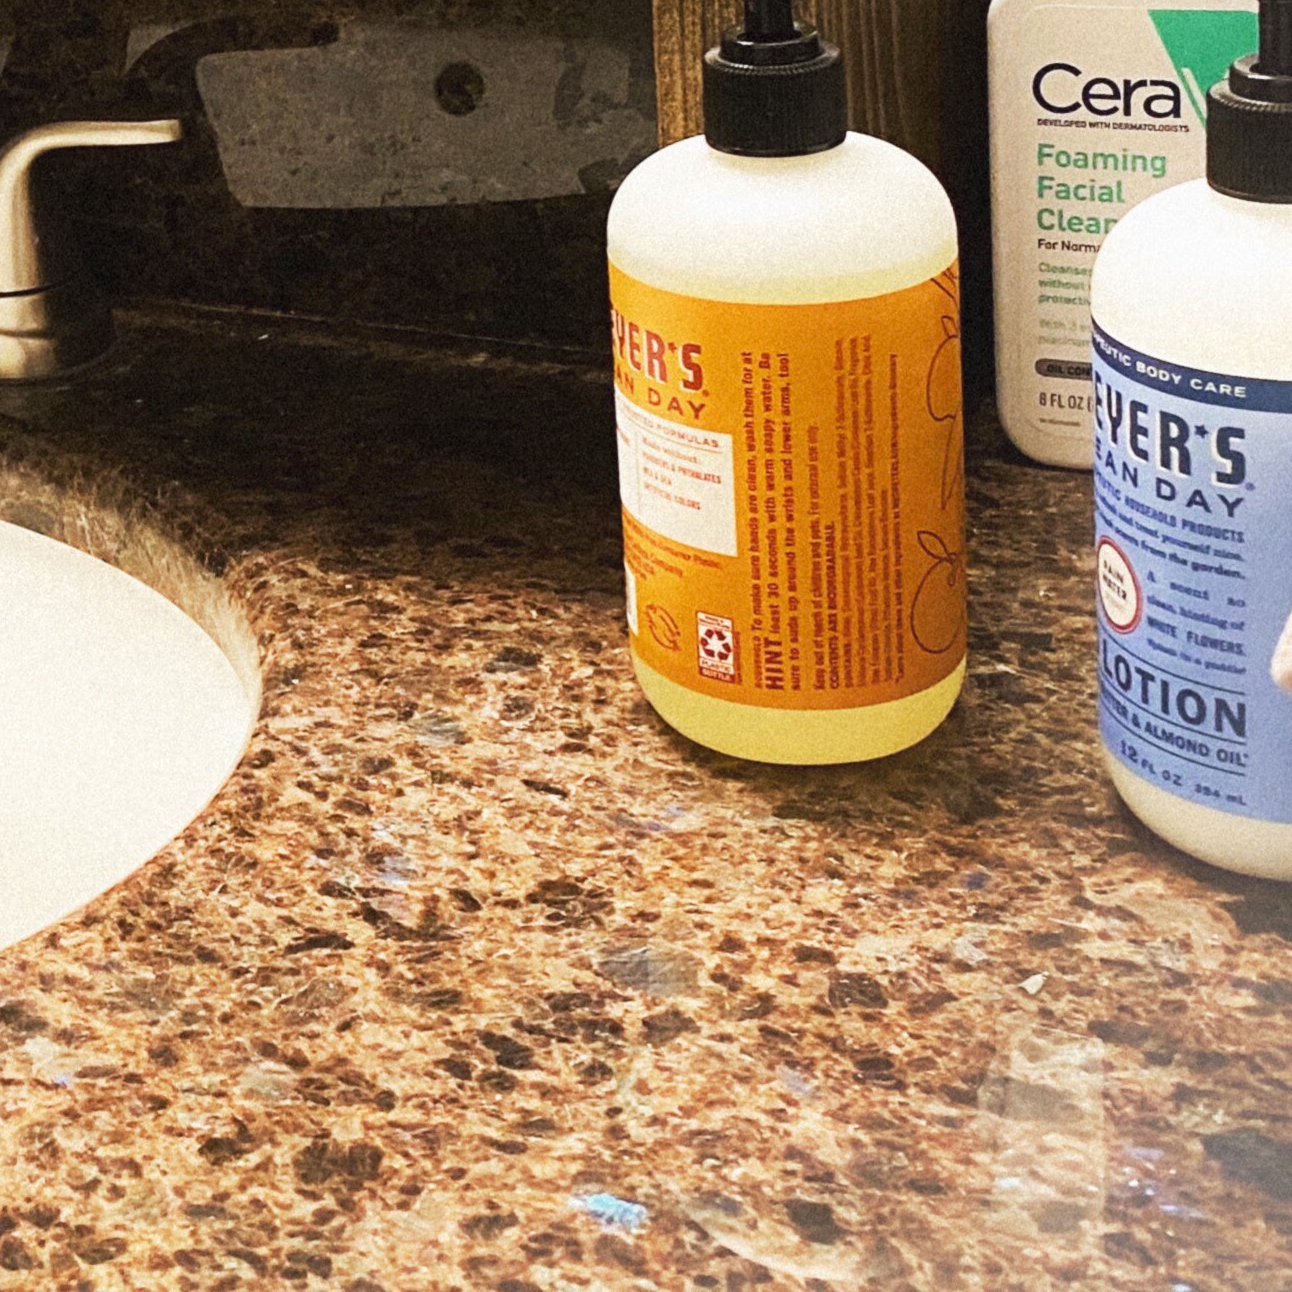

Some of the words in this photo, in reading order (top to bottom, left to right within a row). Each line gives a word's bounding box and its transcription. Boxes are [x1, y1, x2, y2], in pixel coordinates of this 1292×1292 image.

[1037, 118, 1087, 128] DEVELOPED
[1088, 120, 1110, 130] WITH
[1112, 122, 1190, 133] DERMATOLOGISTS
[1037, 142, 1167, 179] Foaming
[1037, 175, 1125, 203] Facial
[1037, 238, 1059, 250] For
[740, 351, 753, 365] at
[741, 367, 753, 385] for
[1135, 360, 1182, 385] BODY
[1190, 378, 1247, 398] CARE
[648, 387, 706, 420] DAY
[742, 387, 754, 418] them
[760, 375, 772, 413] water.
[1050, 392, 1066, 409] FL
[1068, 395, 1084, 410] OZ
[743, 421, 756, 452] wash
[763, 418, 776, 454] soapy
[780, 421, 792, 454] lower
[745, 455, 758, 491] clean,
[764, 459, 776, 491] warm
[780, 459, 793, 481] and
[749, 495, 758, 514] are
[763, 496, 776, 524] with
[782, 486, 794, 523] wrists
[1155, 476, 1245, 518] DAY
[747, 517, 759, 552] hands
[784, 527, 795, 547] the
[1161, 534, 1211, 555] yourself
[1181, 518, 1245, 544] PRODUCTS
[750, 555, 761, 581] sure
[765, 528, 778, 577] seconds
[824, 521, 837, 610] BIODEGRADABLE.
[1140, 539, 1167, 559] from
[1168, 552, 1188, 566] the
[1191, 561, 1246, 580] garden.
[785, 551, 798, 592] around
[749, 583, 762, 616] make
[766, 583, 780, 598] 30
[788, 596, 800, 611] up
[1146, 570, 1157, 584] A
[1169, 582, 1210, 601] scent
[1226, 596, 1246, 608] so
[750, 618, 763, 631] To
[768, 604, 781, 634] least
[827, 613, 837, 632] ARE
[1146, 615, 1178, 639] WHITE
[1229, 620, 1246, 632] of
[763, 637, 785, 690] HINT
[788, 647, 800, 660] to
[828, 636, 839, 690] CONTENTS
[791, 665, 801, 691] sure
[813, 668, 826, 690] Keep
[1102, 638, 1247, 738] LOTION
[1131, 713, 1142, 729] &
[1144, 721, 1211, 757] ALMOND
[1120, 739, 1138, 763] 12
[1141, 758, 1156, 775] FL
[1162, 769, 1183, 787] OZ
[1226, 793, 1247, 806] mL
